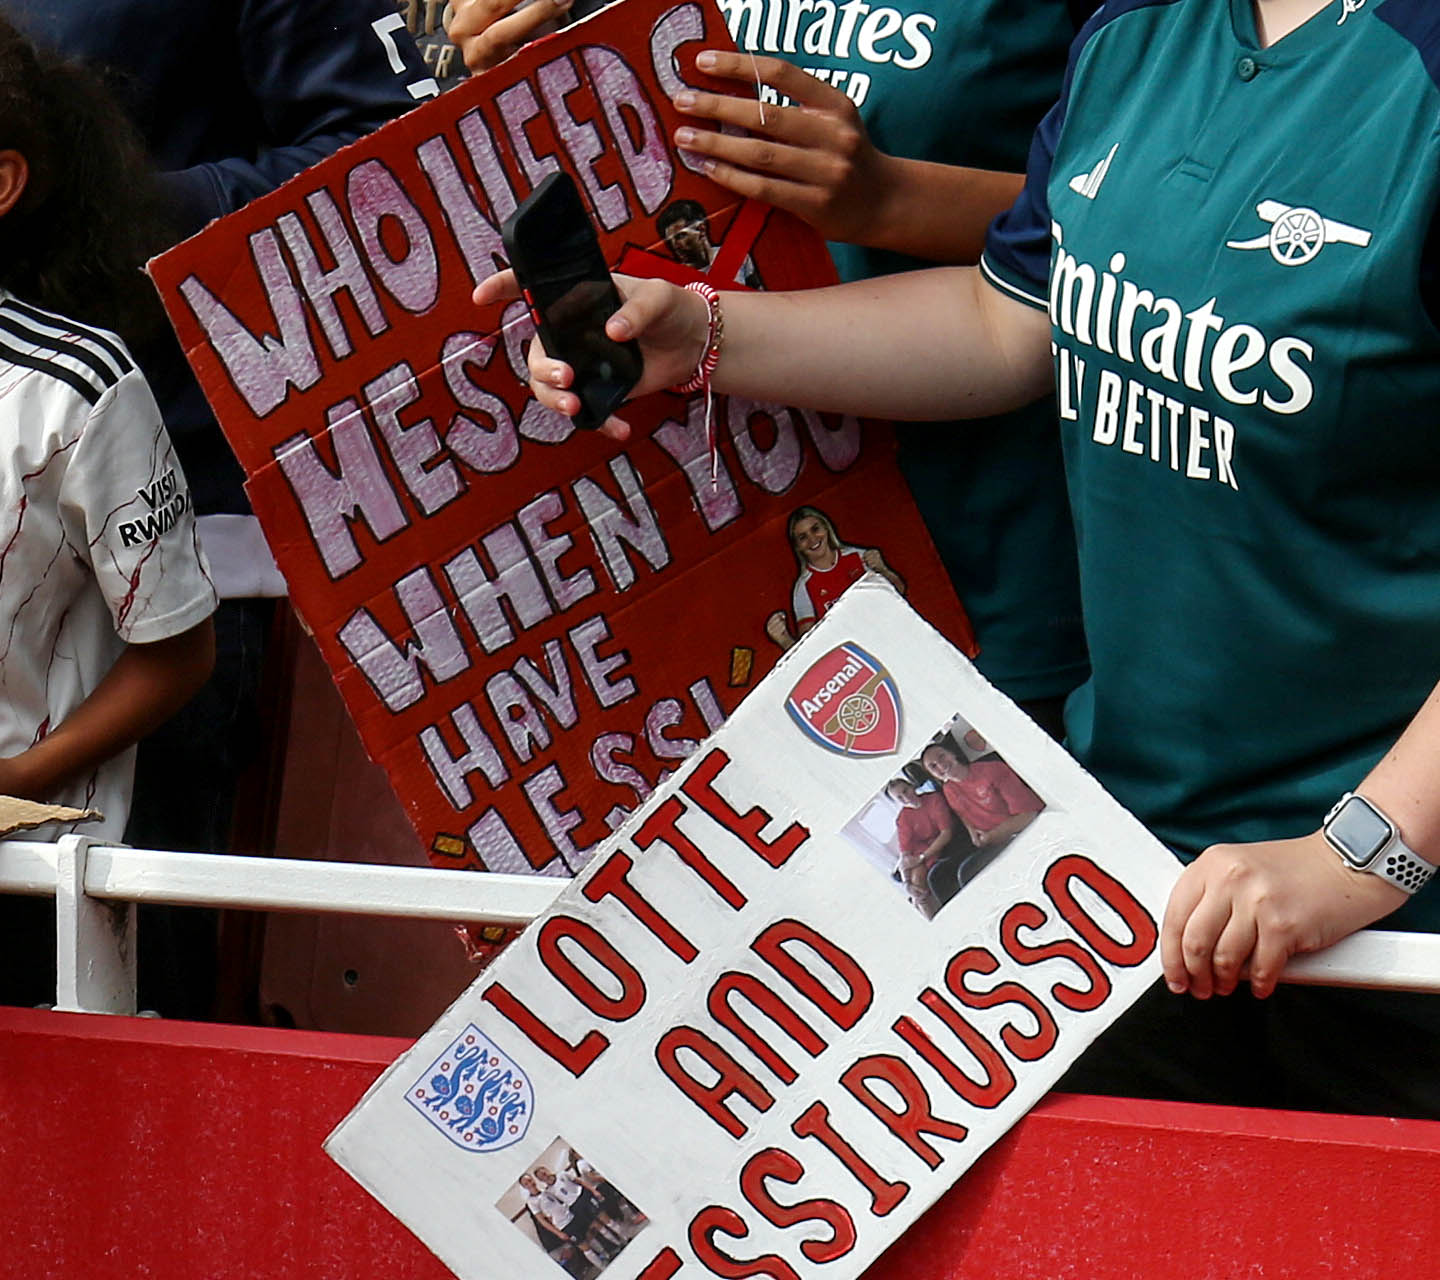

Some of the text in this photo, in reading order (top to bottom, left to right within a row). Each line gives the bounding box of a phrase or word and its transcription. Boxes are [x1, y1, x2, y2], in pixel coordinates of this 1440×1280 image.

[178, 154, 442, 420] WHO
[1050, 217, 1315, 416] mirates
[1092, 367, 1239, 493] BETTER
[336, 455, 671, 717] WHEN
[799, 656, 864, 724] Arsenal
[418, 615, 639, 813] HAVE
[481, 746, 811, 1078] LOTTE
[654, 917, 874, 1139] AND
